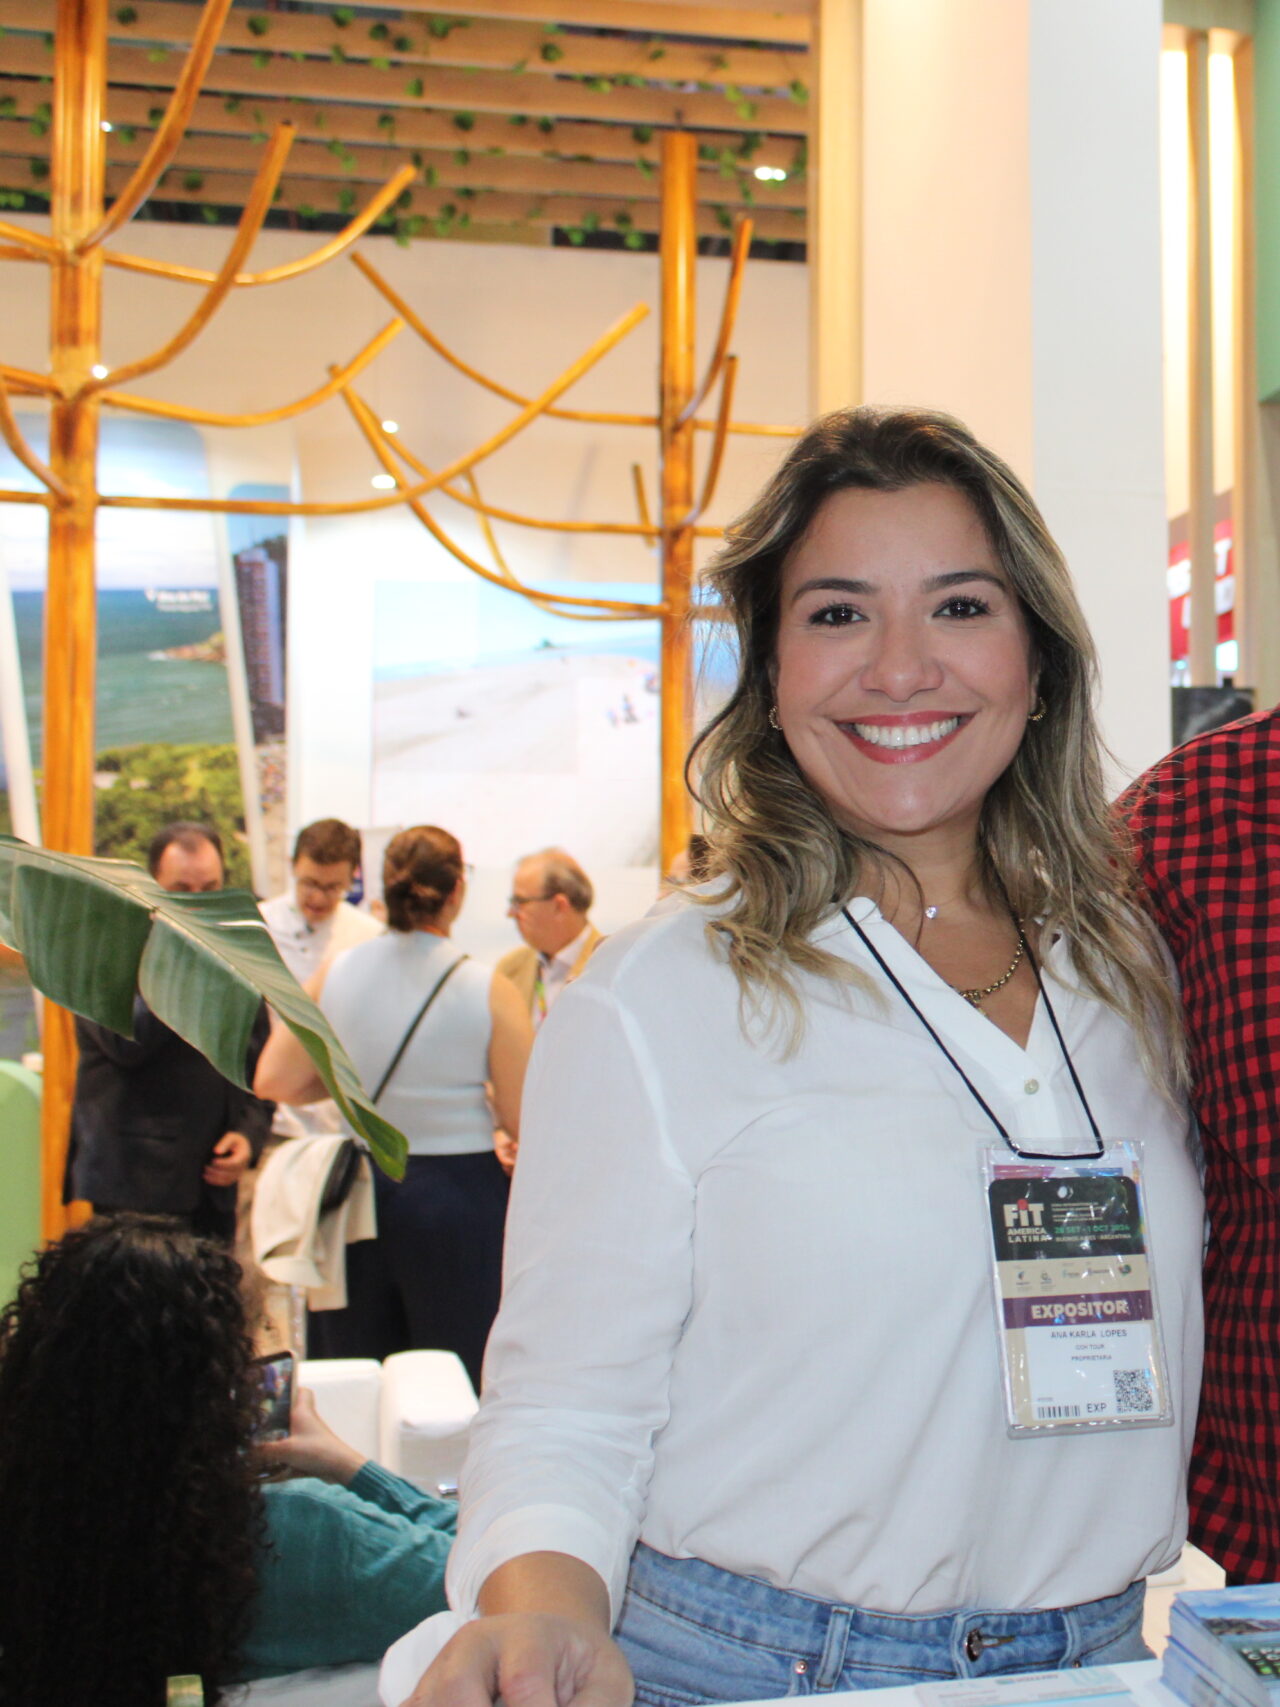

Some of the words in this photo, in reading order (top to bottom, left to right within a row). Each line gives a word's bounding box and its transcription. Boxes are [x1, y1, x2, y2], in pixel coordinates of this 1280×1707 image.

[1007, 1227, 1047, 1236] AMERICA
[1008, 1235, 1050, 1243] LATINA
[1031, 1300, 1129, 1319] EXPOSITOR
[1069, 1330, 1096, 1338] KARLA
[1101, 1329, 1127, 1337] LOPES
[1087, 1403, 1107, 1413] EXP
